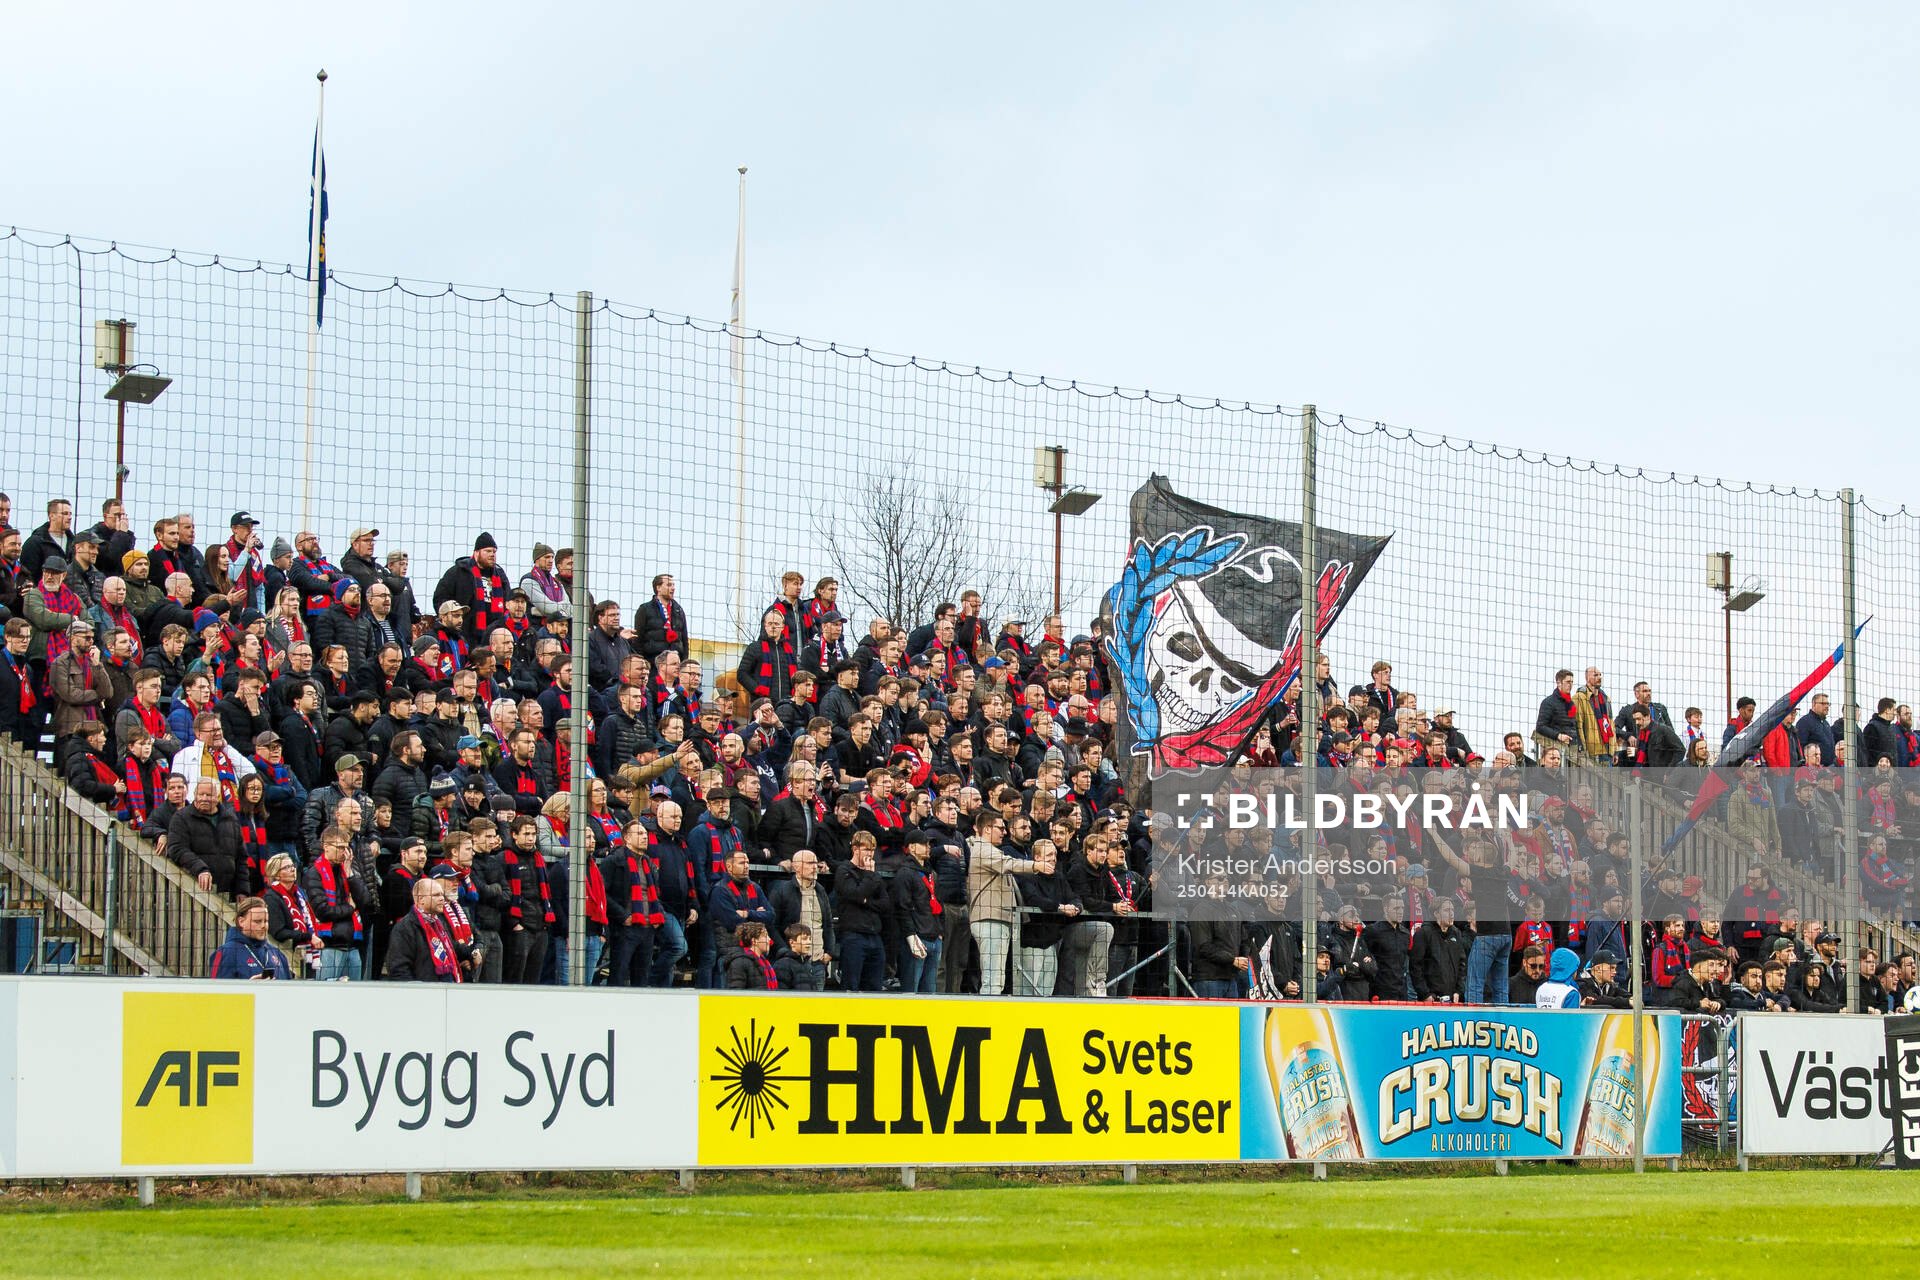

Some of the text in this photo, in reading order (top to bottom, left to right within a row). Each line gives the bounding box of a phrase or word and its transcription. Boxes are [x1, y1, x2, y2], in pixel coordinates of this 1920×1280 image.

[1082, 1029, 1193, 1076] Svets
[1401, 1020, 1539, 1059] HALMSTAD
[135, 1050, 240, 1107] AF
[312, 1029, 615, 1132] Bygg Syd
[798, 1022, 1073, 1135] HMA
[1284, 1060, 1332, 1096] HALMSTAD
[1589, 1077, 1636, 1122] CRUS
[1599, 1064, 1635, 1093] HALMST
[1082, 1088, 1232, 1134] & Laser
[1282, 1072, 1347, 1132] CRUSH
[1378, 1054, 1564, 1149] CRUSH
[1431, 1133, 1511, 1152] ALKOHOLFRI
